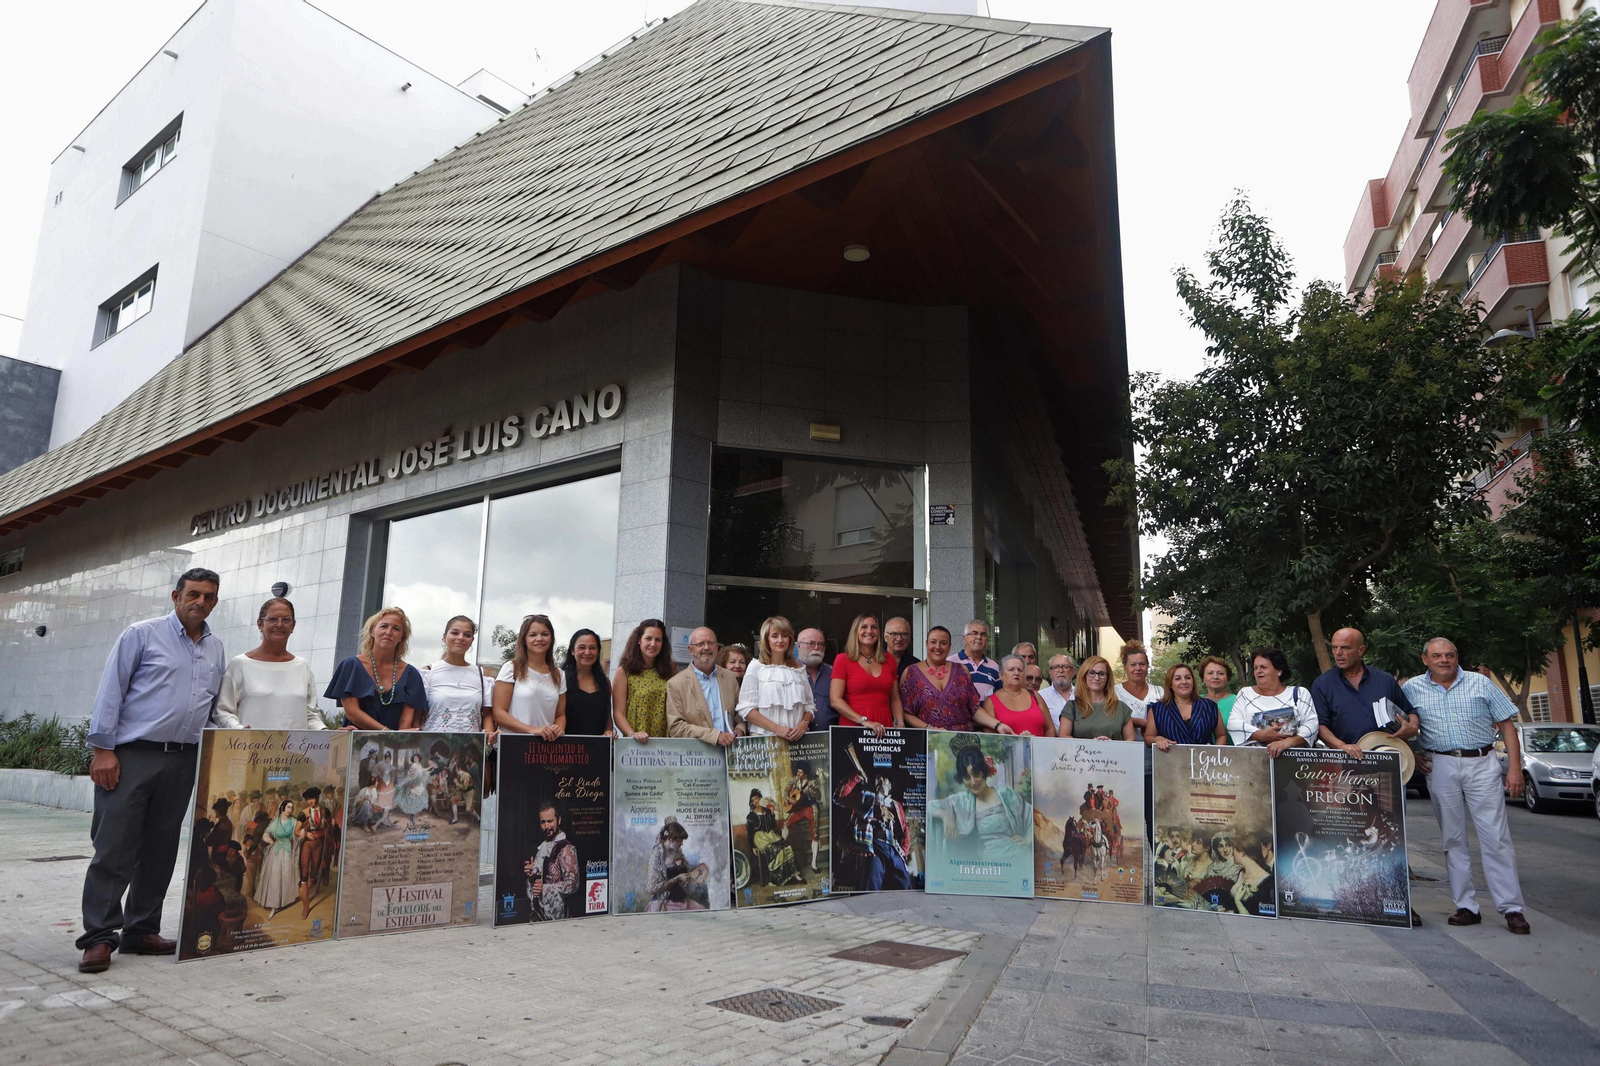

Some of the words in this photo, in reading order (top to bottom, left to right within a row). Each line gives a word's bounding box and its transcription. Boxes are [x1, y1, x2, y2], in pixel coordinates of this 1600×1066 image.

[190, 500, 248, 536] CENTRO
[255, 459, 383, 518] DOCUMENTAL
[387, 428, 453, 480] JOSÉ
[457, 415, 522, 461] LUIS
[529, 383, 624, 439] CANO
[222, 734, 277, 750] Mercado
[280, 734, 294, 750] de
[298, 736, 332, 756] Época
[529, 742, 535, 753] II
[538, 742, 575, 754] ENCUENTRO
[578, 744, 585, 753] DE
[735, 740, 780, 753] Encuentro
[1076, 745, 1103, 755] Paseo
[244, 750, 312, 766] Romántica
[524, 753, 547, 764] TEATRO
[621, 754, 666, 766] CULTURAS
[680, 754, 721, 766] ESTRECHO
[1059, 753, 1070, 762] de
[1074, 754, 1119, 768] Carruajes
[1199, 748, 1232, 770] Gala
[754, 759, 778, 776] Copla
[558, 777, 574, 787] El
[575, 777, 601, 788] Lindo
[554, 788, 572, 799] don
[575, 788, 604, 802] Diego
[1306, 790, 1373, 805] PREGÓN
[630, 805, 657, 814] Algeciras
[631, 816, 657, 824] mares
[960, 865, 1001, 876] Infantil
[385, 888, 395, 903] V
[398, 887, 444, 902] FESTIVAL
[386, 904, 430, 916] FOLKLORE
[385, 913, 436, 928] ESTRECHO
